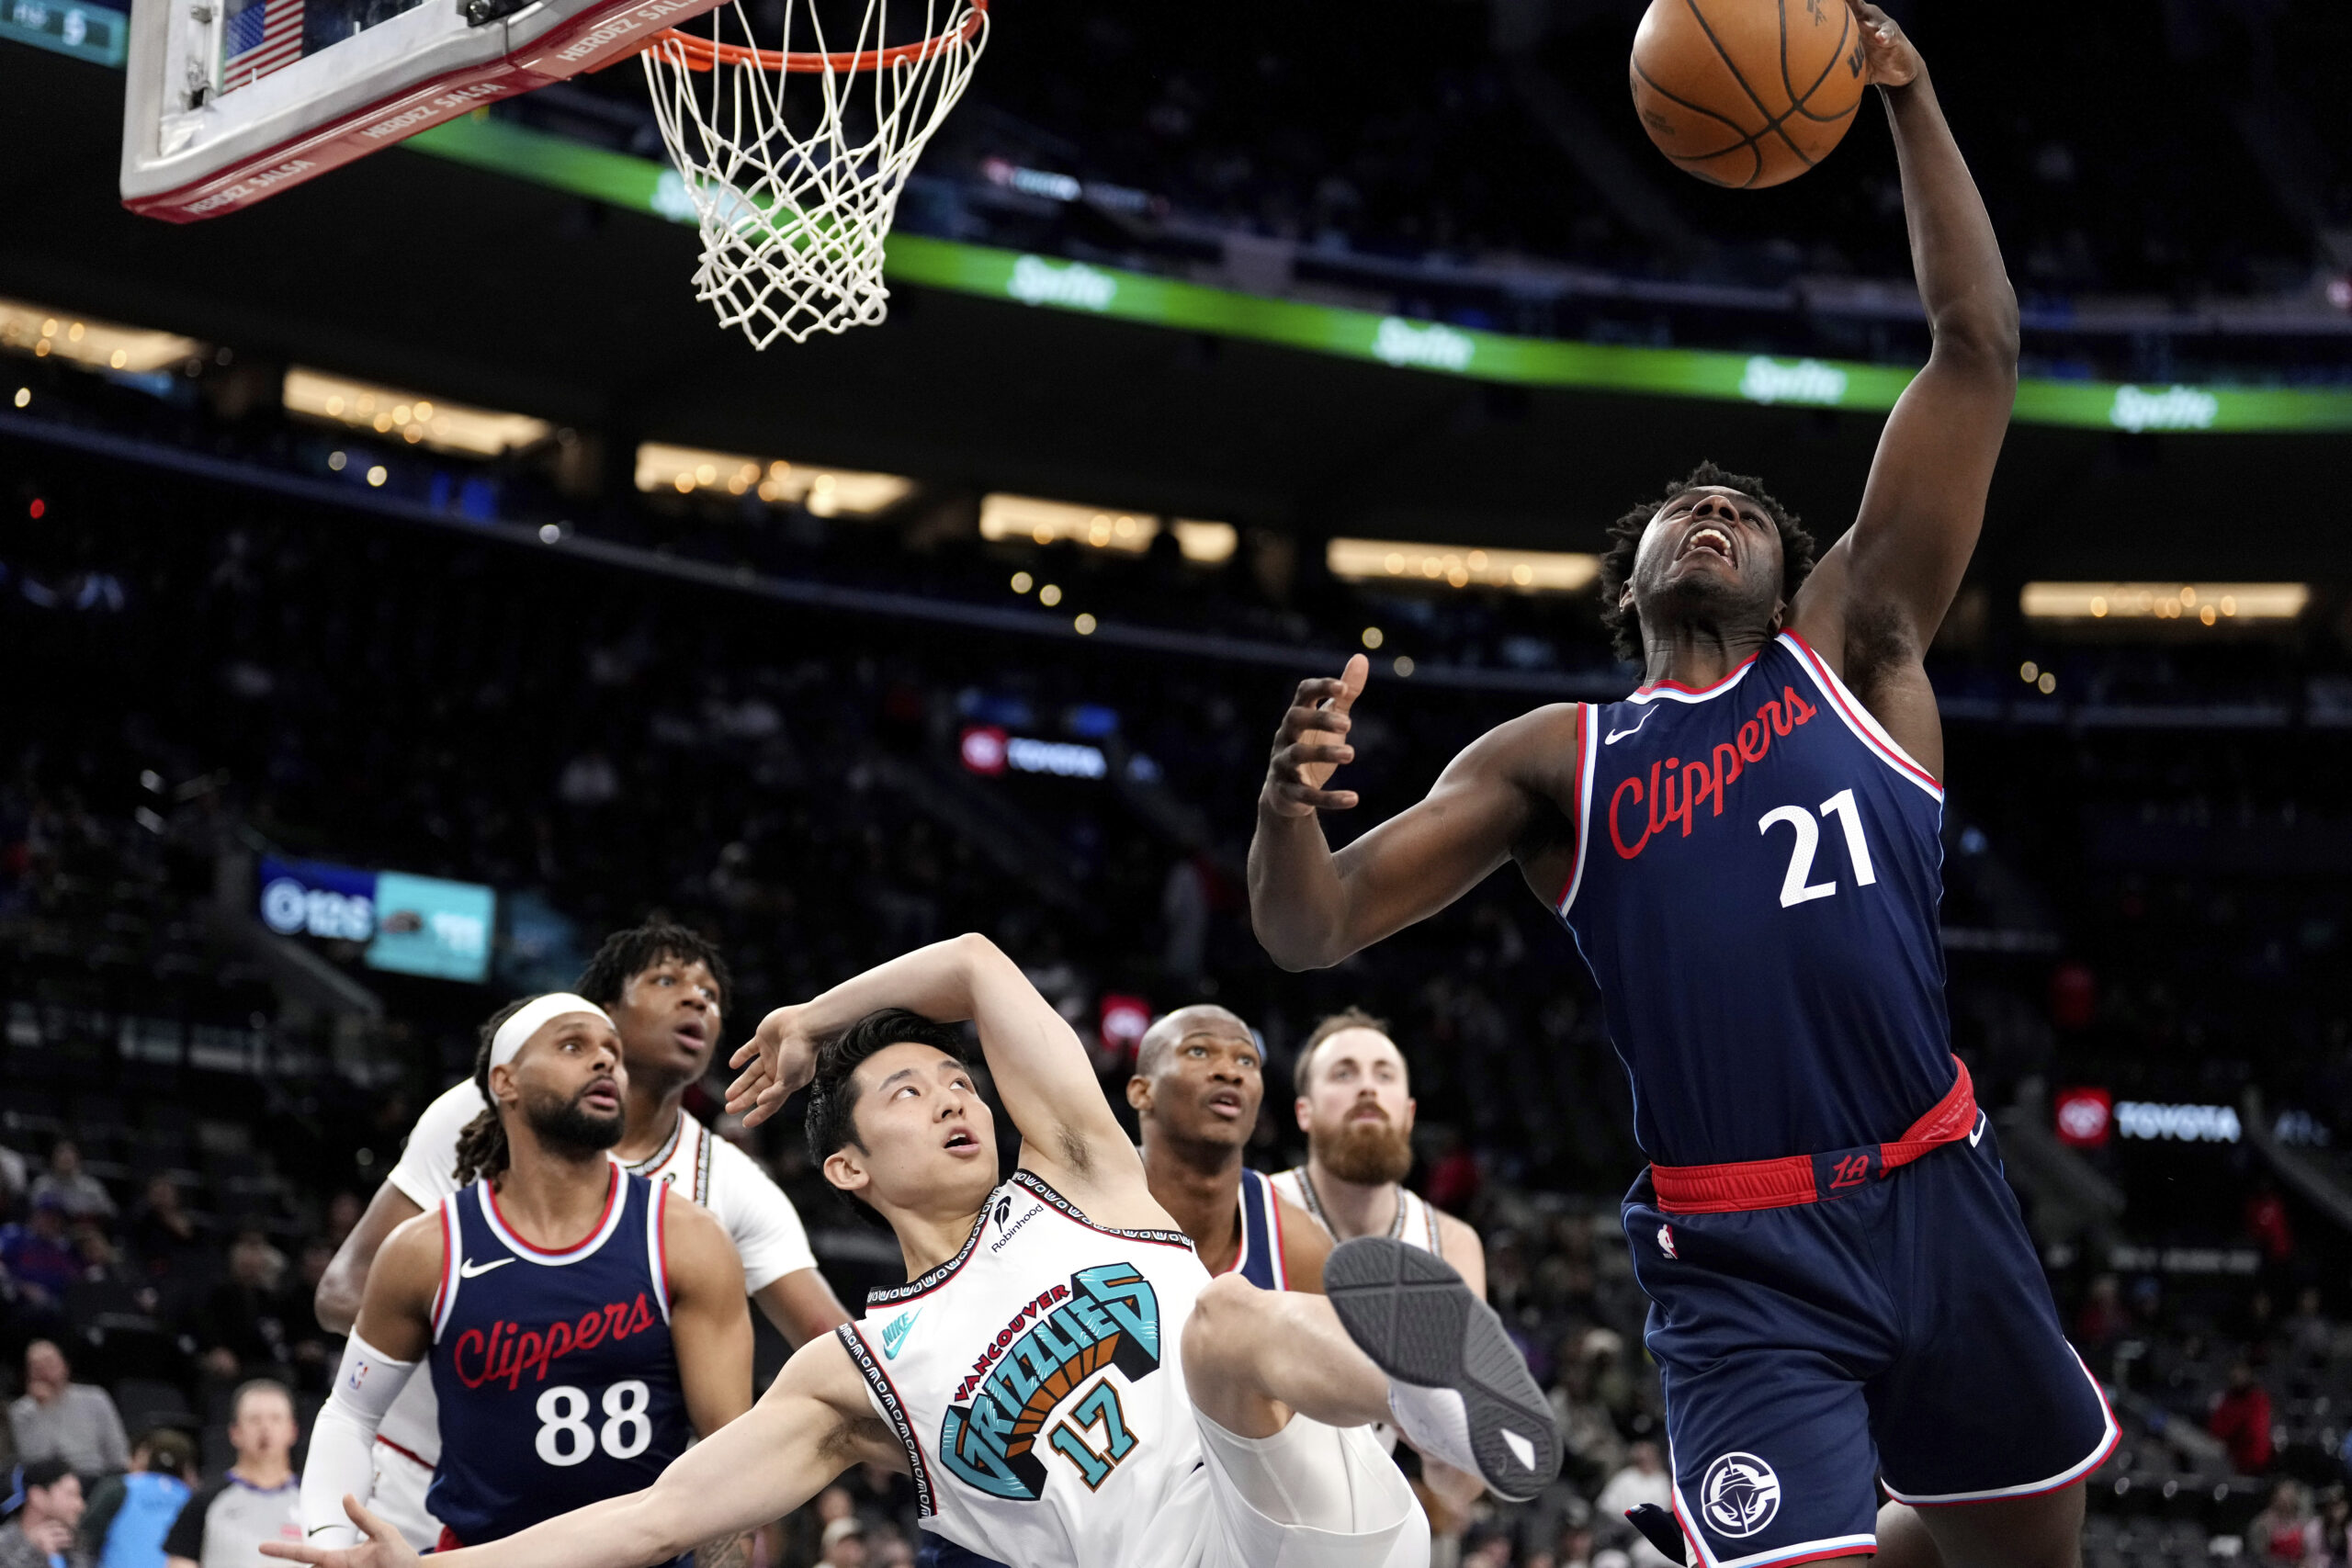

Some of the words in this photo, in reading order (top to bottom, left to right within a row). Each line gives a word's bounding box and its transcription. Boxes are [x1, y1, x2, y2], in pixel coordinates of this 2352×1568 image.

[557, 18, 642, 62] HERDEZ
[637, 0, 698, 20] SAL
[361, 105, 439, 139] HERDEZ
[435, 82, 506, 108] SALSA
[251, 159, 316, 187] SALSA
[1609, 685, 1817, 860] Clippers
[1758, 788, 1877, 908] 21
[2114, 1101, 2243, 1144] TOYOTA
[1829, 1155, 1870, 1190] LA
[990, 1202, 1045, 1254] Robinhood
[454, 1292, 656, 1392] Clippers
[882, 1311, 910, 1348] NIKE
[954, 1284, 1071, 1402] VANCOUVER
[940, 1261, 1160, 1501] GRIZZLIES
[535, 1380, 652, 1467] 88
[1047, 1376, 1140, 1493] 17
